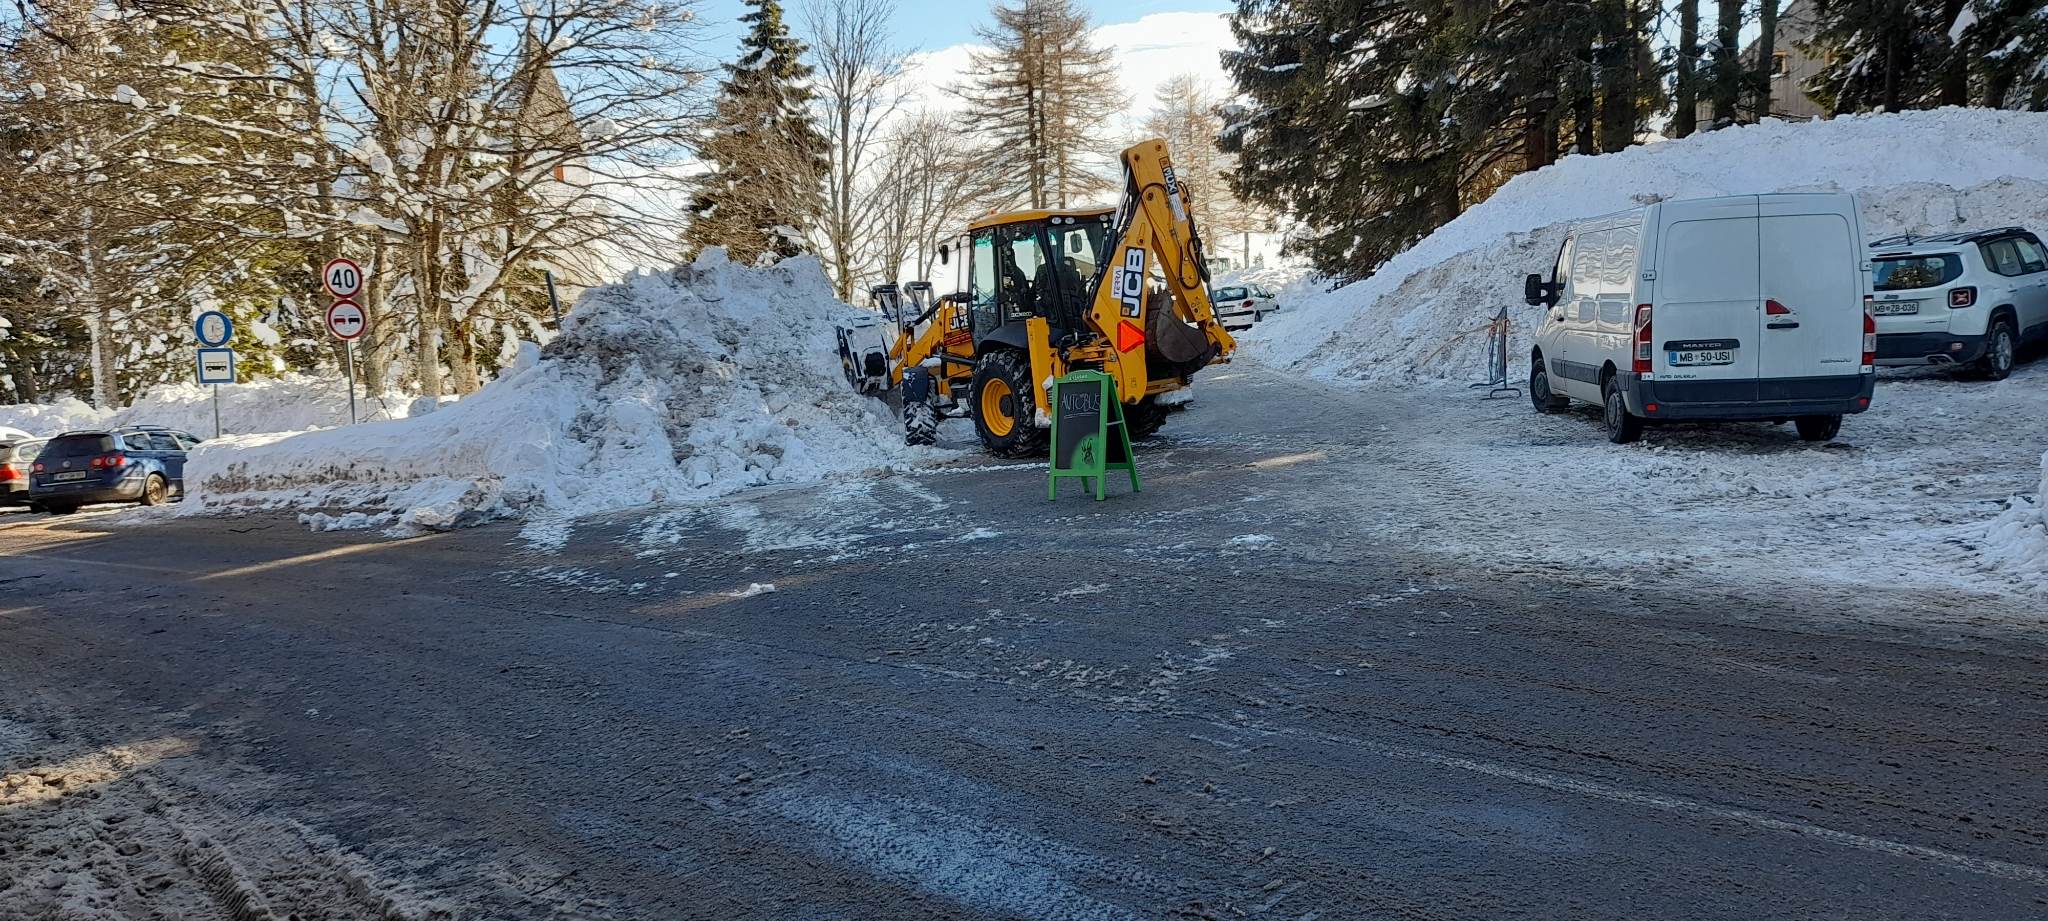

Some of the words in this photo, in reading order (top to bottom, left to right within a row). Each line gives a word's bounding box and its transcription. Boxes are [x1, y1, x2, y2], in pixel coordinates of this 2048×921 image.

[331, 269, 355, 288] 40
[1122, 248, 1144, 316] JCB
[1680, 352, 1694, 362] MB
[1700, 351, 1730, 362] 50-USI
